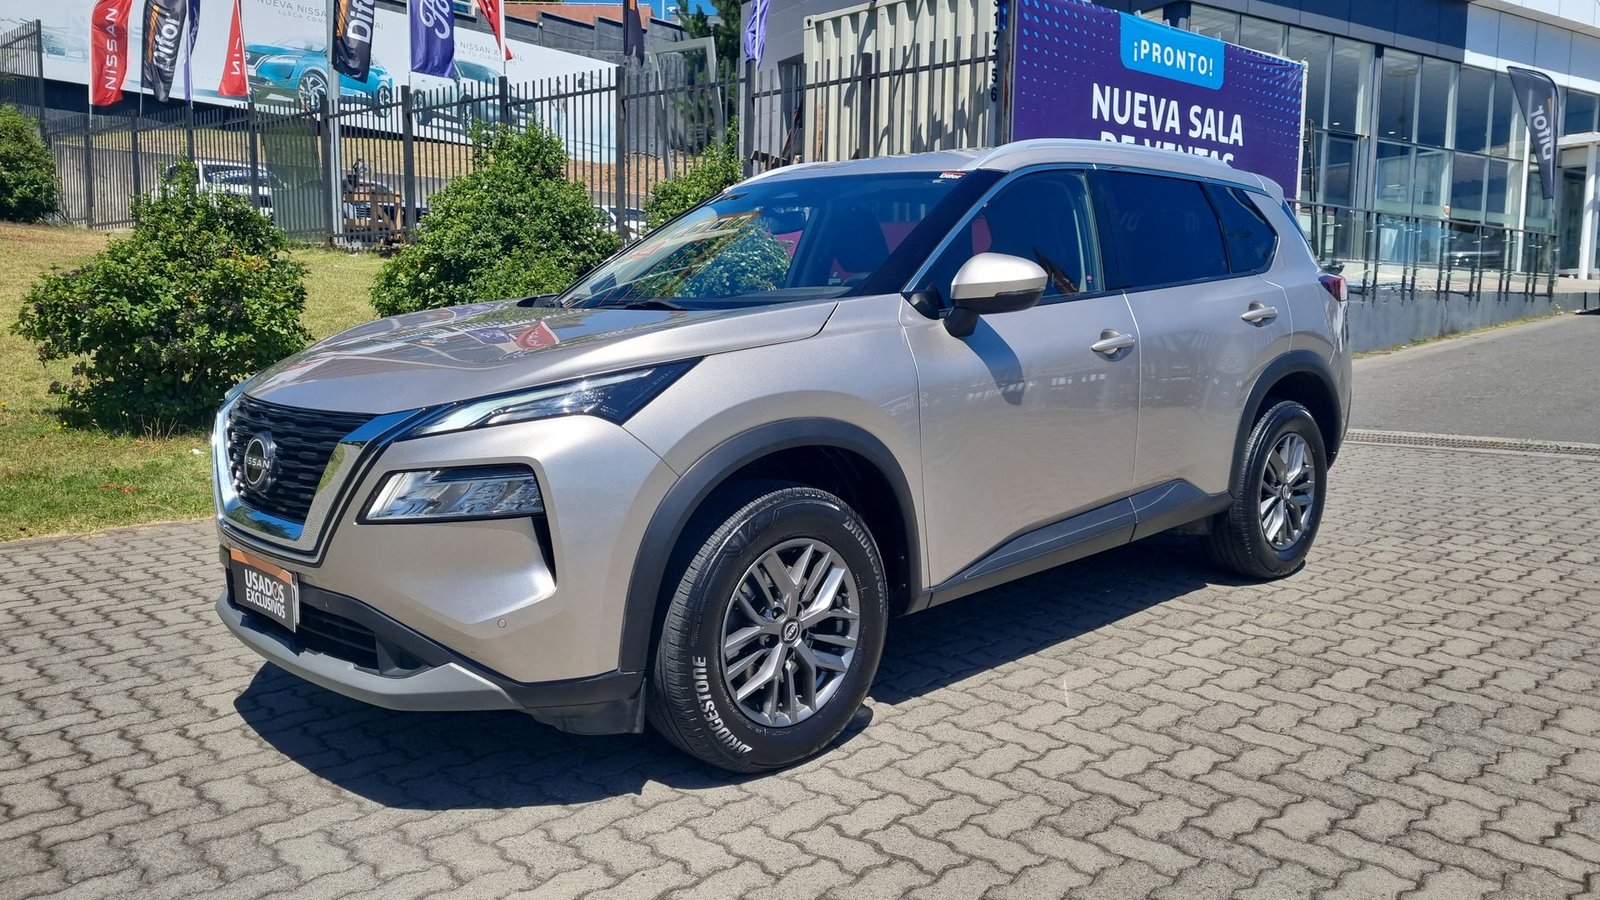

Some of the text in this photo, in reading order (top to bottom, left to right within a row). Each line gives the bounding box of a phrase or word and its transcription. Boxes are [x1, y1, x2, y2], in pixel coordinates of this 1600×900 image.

[297, 4, 327, 17] NISSA
[347, 0, 374, 44] Dif
[105, 8, 118, 90] NISSAN
[460, 41, 491, 54] NISSAN
[1133, 40, 1213, 77] ¡PRONTO!
[1092, 82, 1243, 146] NUEVA SALA
[245, 569, 285, 604] USADOS
[246, 588, 286, 619] EXCLUSIVOS
[692, 656, 753, 753] BRIDGESTONE
